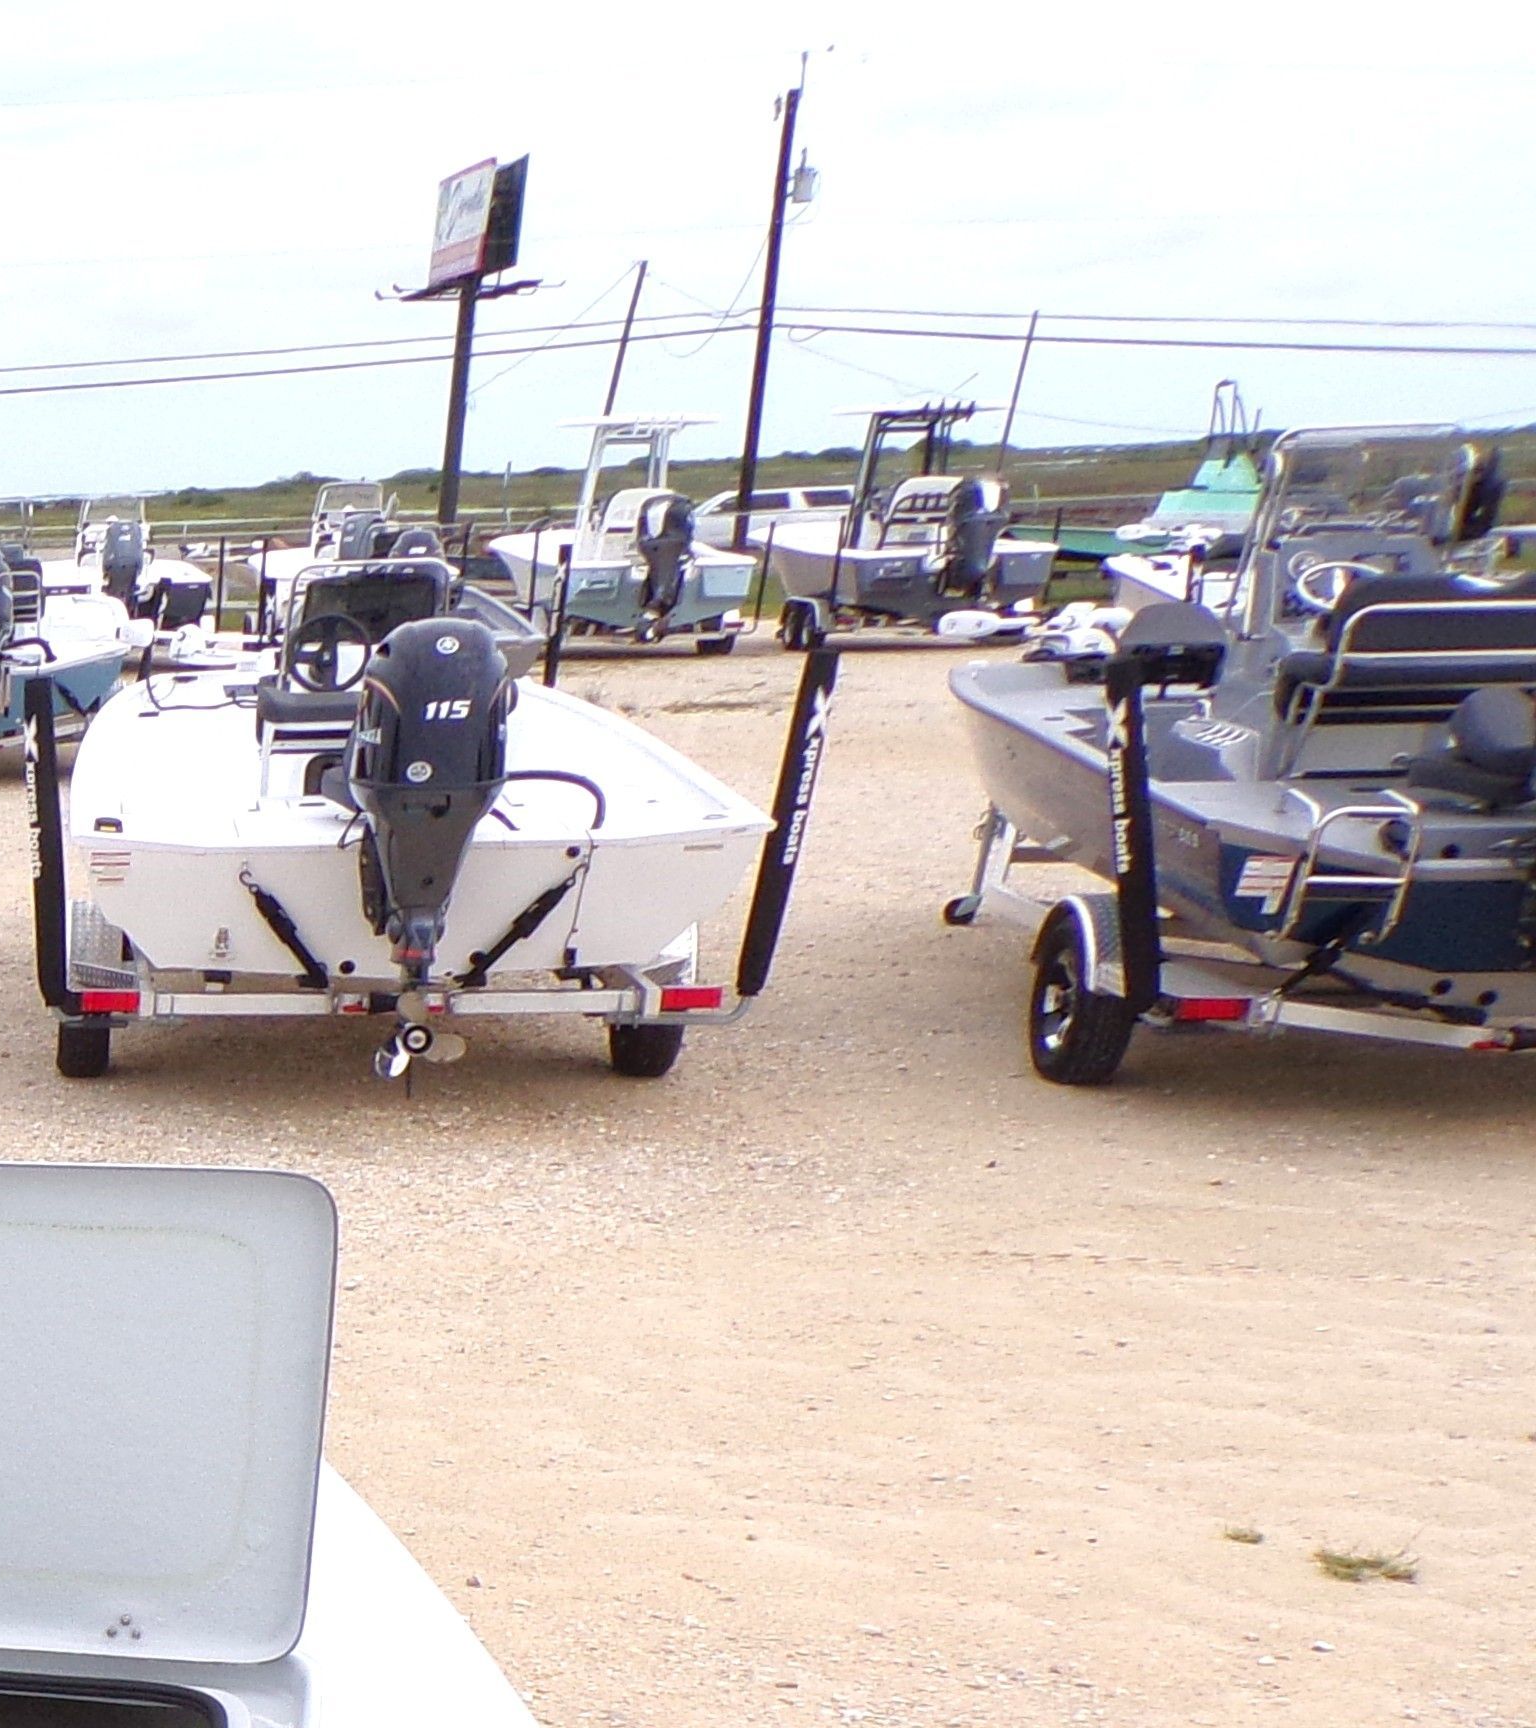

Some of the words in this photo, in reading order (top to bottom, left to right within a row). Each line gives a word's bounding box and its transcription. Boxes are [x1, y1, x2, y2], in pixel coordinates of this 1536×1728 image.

[425, 700, 471, 720] 115
[783, 810, 807, 865] boats
[1114, 819, 1133, 875] boats
